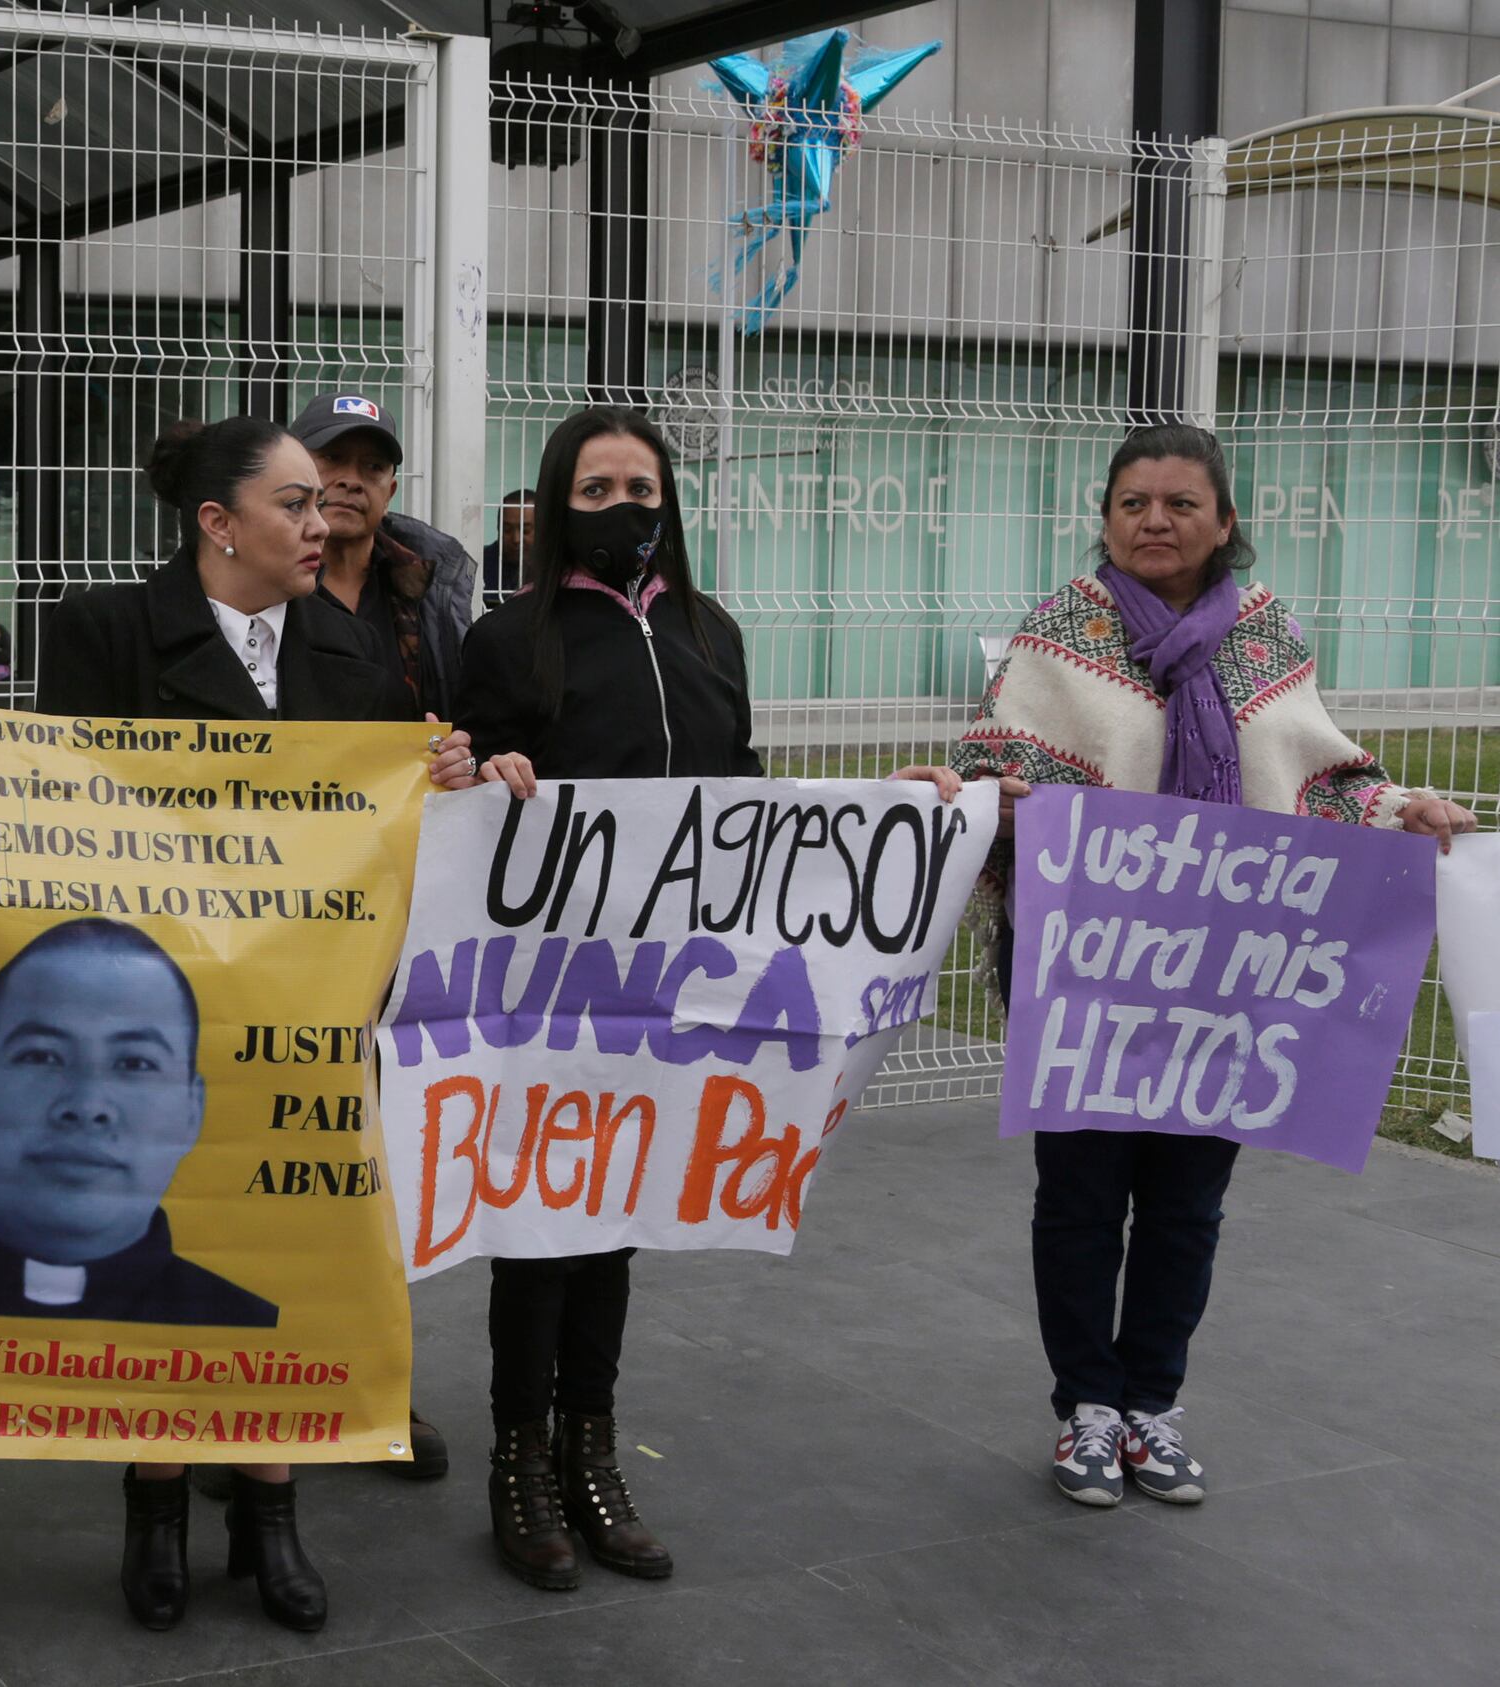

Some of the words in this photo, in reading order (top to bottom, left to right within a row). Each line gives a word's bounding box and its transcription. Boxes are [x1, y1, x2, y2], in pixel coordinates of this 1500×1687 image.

[764, 377, 874, 412] SEGOB
[672, 471, 908, 533] CENTRO
[1257, 486, 1346, 540] PEN
[73, 721, 180, 751] Señor
[189, 724, 271, 753] Juez
[89, 775, 217, 809] Orozco
[225, 780, 376, 816] Treviño,
[107, 831, 284, 864] JUSTICIA
[487, 784, 616, 937] Un
[629, 785, 966, 954] Agresor
[1038, 792, 1338, 914] Justicia
[138, 886, 188, 915] LO
[196, 889, 375, 921] EXPULSE.
[1036, 910, 1208, 997] para
[1218, 929, 1347, 1008] mis
[394, 937, 820, 1071] NUNCA
[234, 1019, 375, 1064] JUSTIC
[1030, 997, 1299, 1129] HIJOS
[268, 1094, 370, 1132] PAR
[244, 1157, 382, 1196] ABNER
[414, 1076, 655, 1267] Buen
